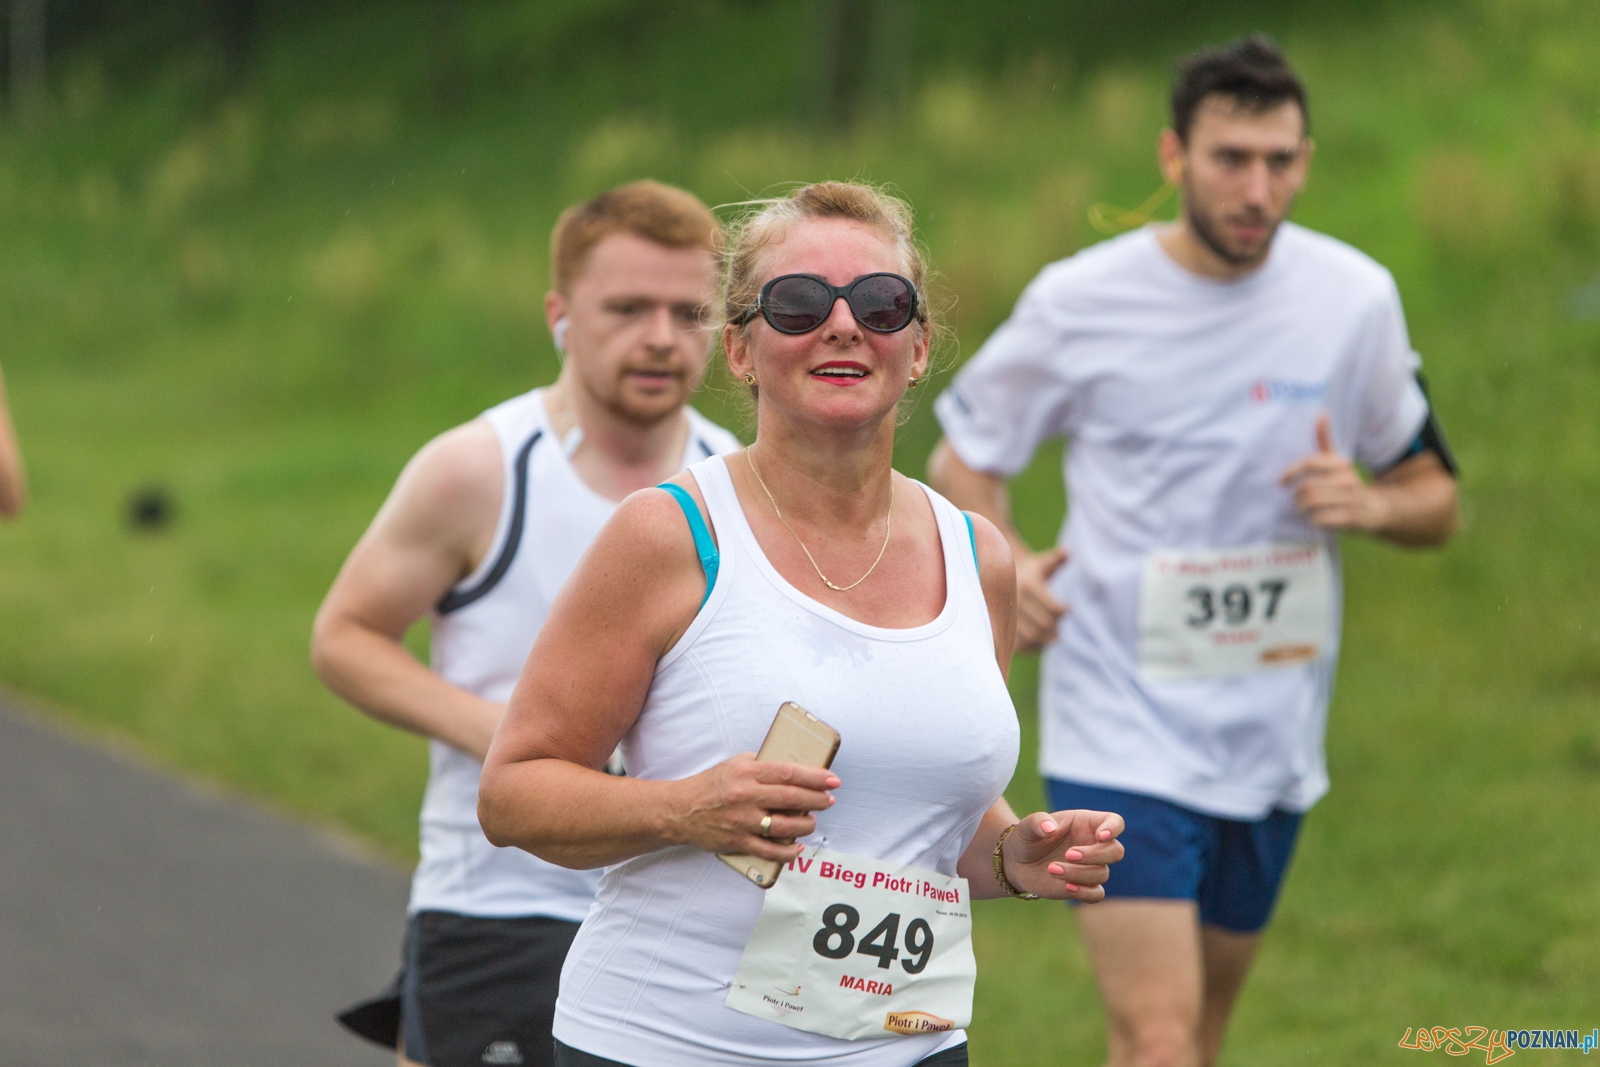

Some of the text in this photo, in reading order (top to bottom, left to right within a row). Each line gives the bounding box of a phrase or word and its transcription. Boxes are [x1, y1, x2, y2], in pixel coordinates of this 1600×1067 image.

[1186, 578, 1289, 629] 397
[788, 856, 960, 904] IV Bieg Piotr i Paweł
[812, 903, 935, 975] 849
[762, 994, 780, 1005] Piotr
[839, 974, 893, 996] MARIA
[888, 1014, 914, 1028] Piotr
[915, 1018, 920, 1029] i
